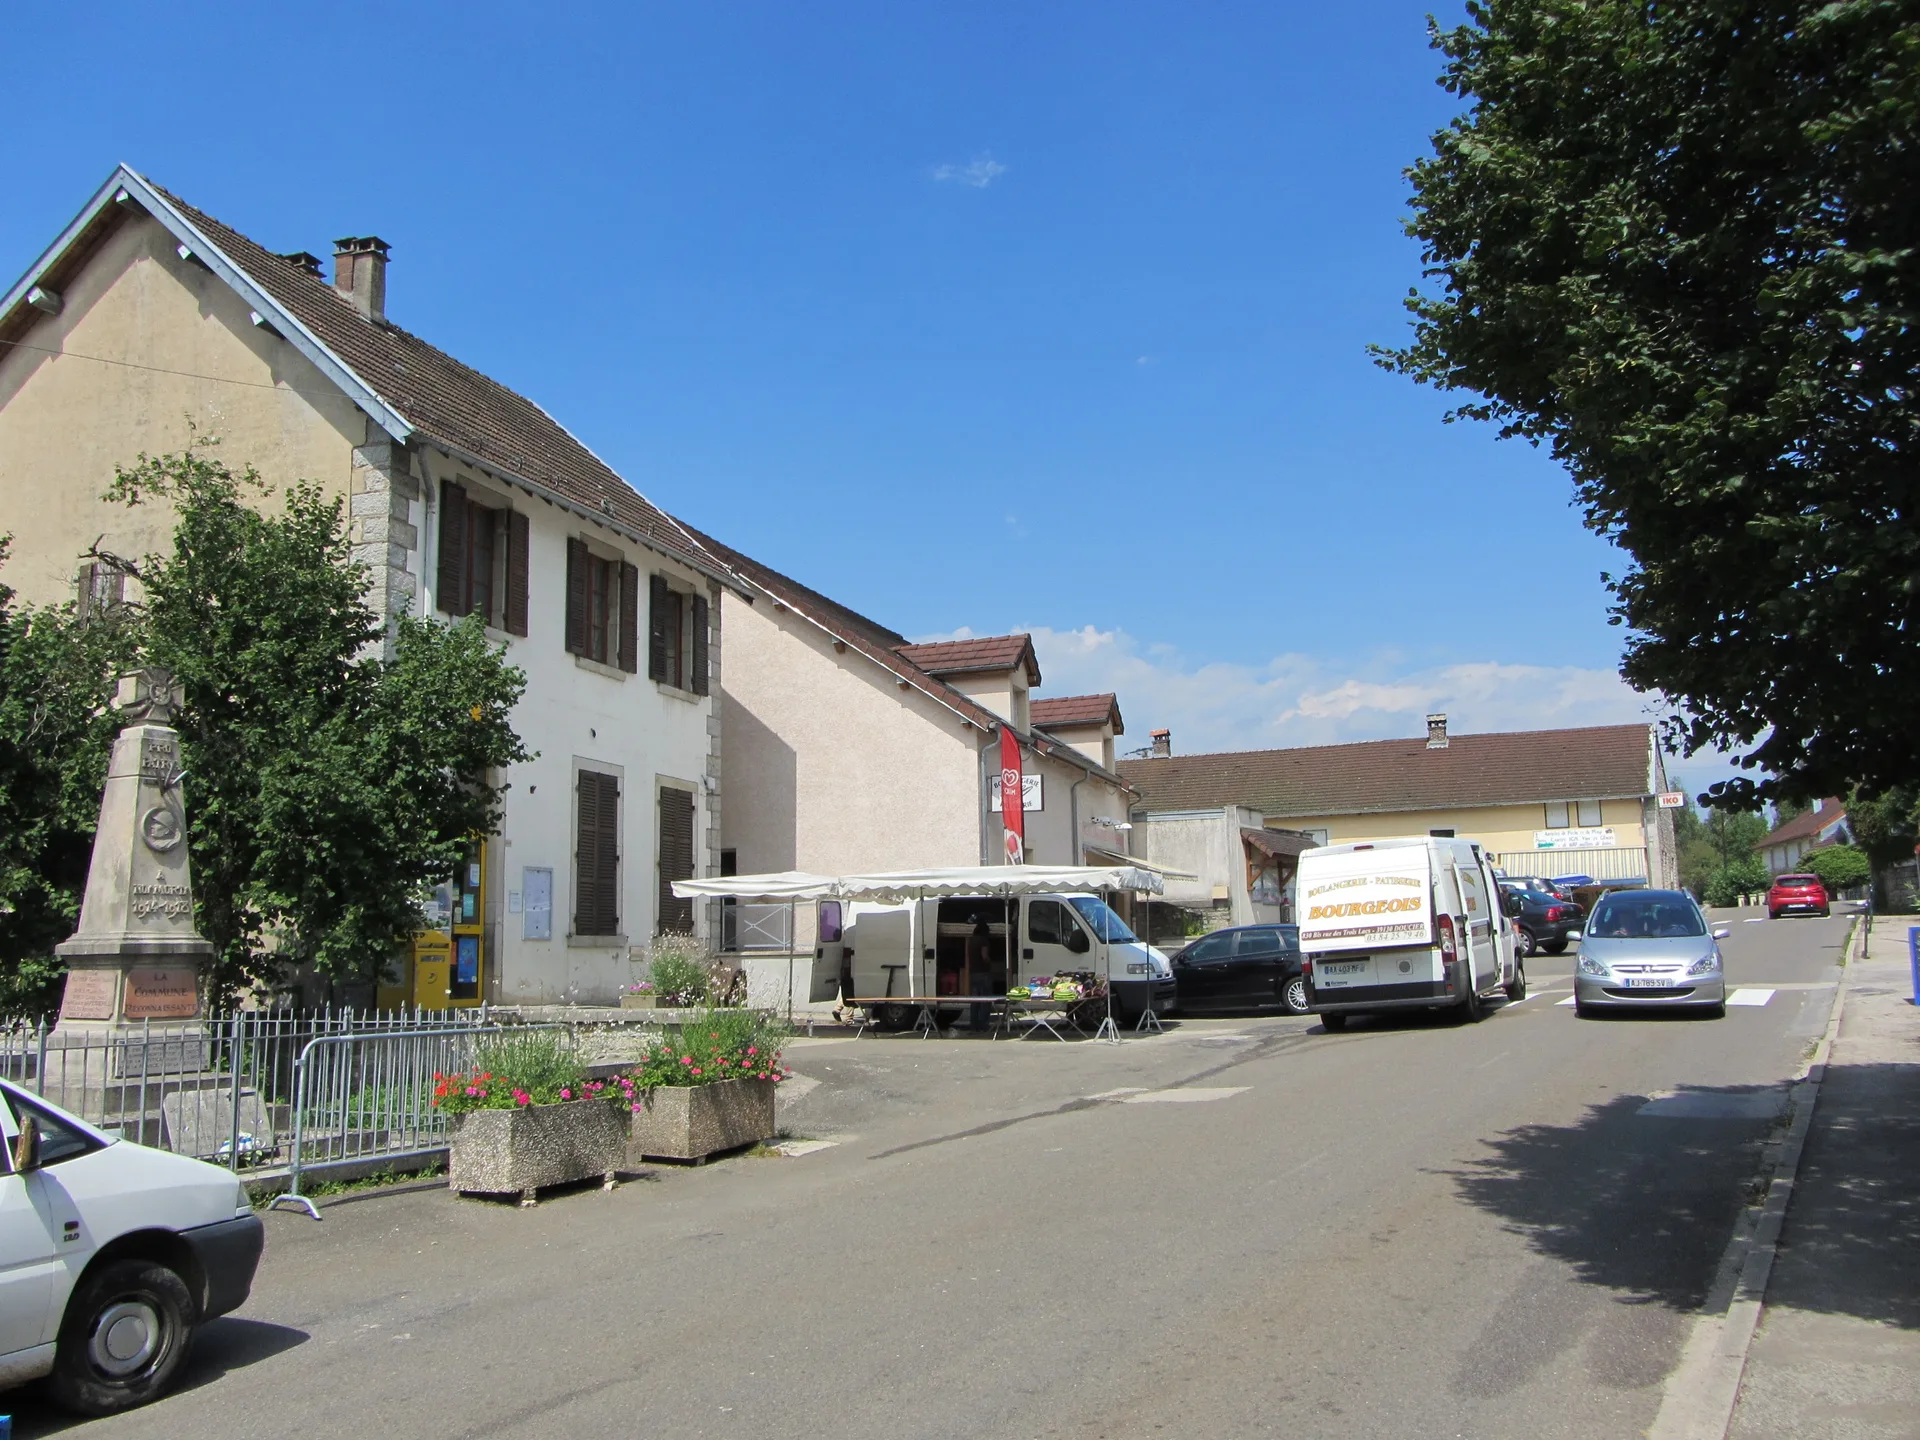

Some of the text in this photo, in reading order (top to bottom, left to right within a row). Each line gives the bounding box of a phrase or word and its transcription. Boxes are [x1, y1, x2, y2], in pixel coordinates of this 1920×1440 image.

[1308, 877, 1368, 898] BOULANGERIE
[1308, 897, 1422, 920] BOURGEOIS
[154, 973, 168, 981] LA
[134, 987, 189, 997] COMMUNE
[126, 1004, 198, 1013] RECONNAISSANTE
